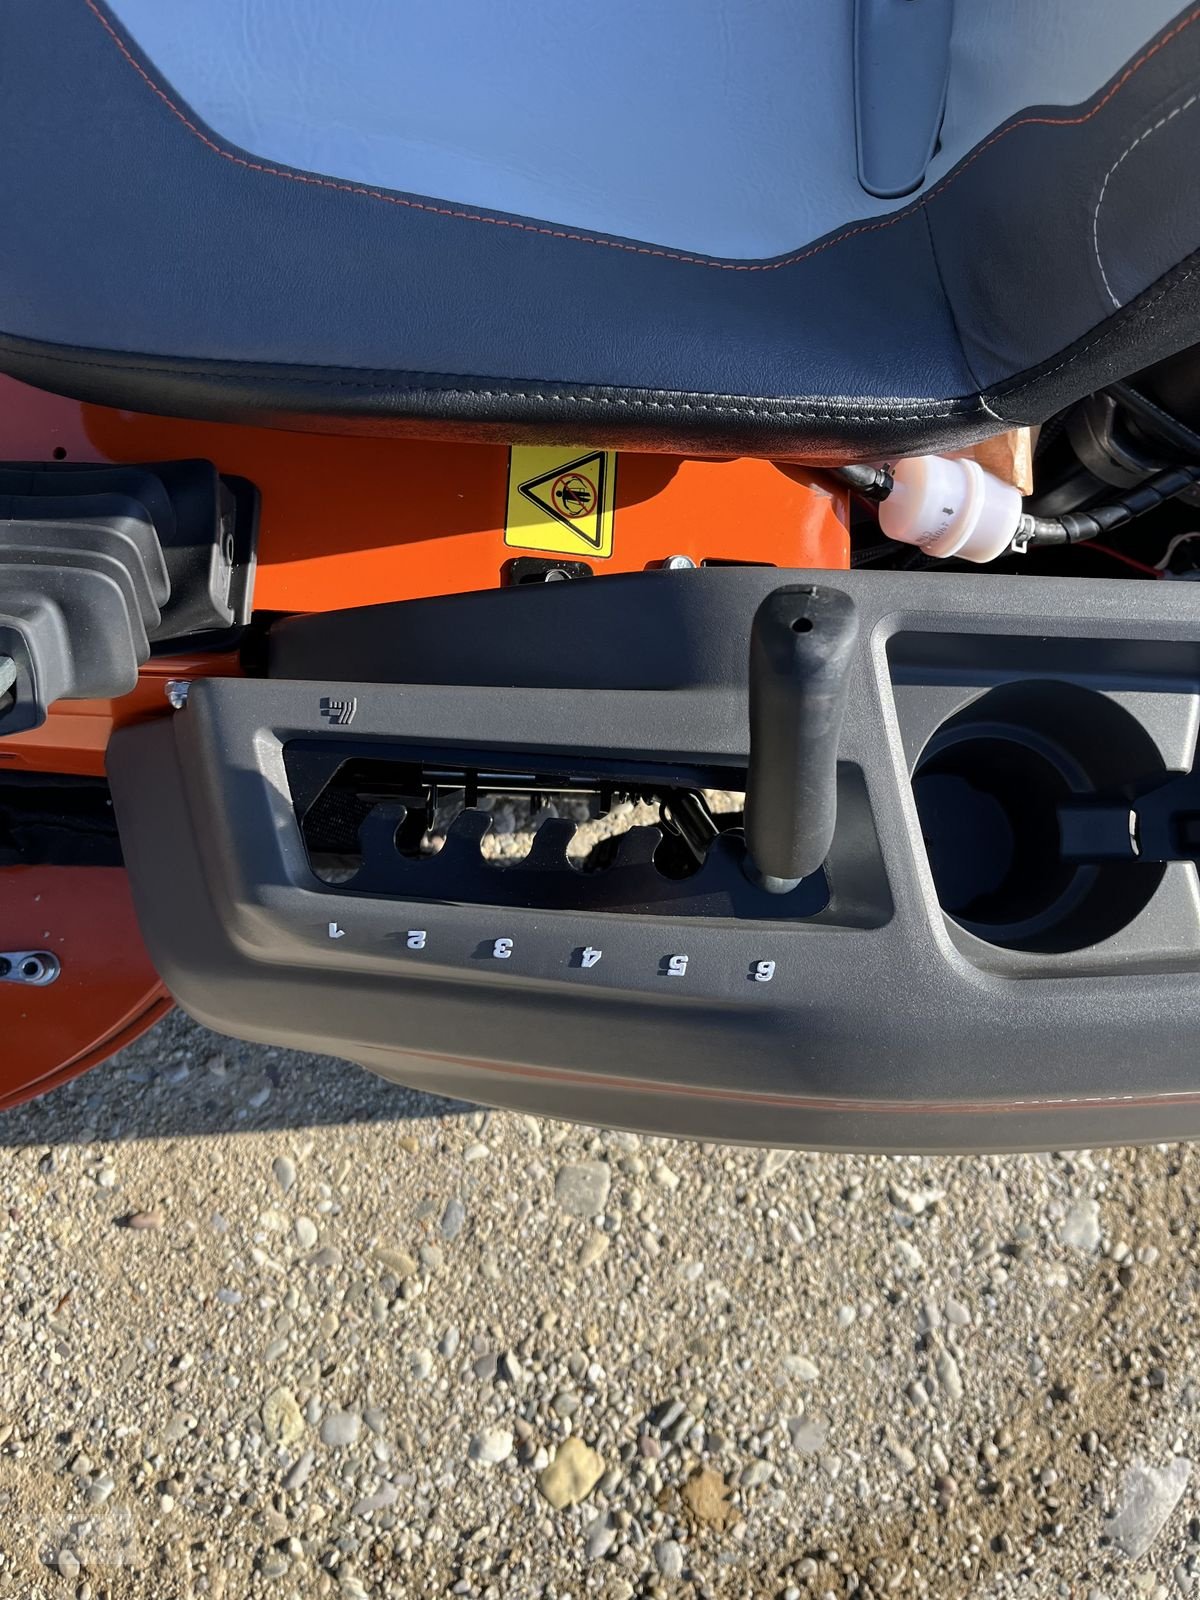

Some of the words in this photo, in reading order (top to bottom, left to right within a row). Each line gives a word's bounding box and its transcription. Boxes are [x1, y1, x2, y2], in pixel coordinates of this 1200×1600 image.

[329, 922, 345, 939] 1
[407, 930, 426, 949] 2
[493, 938, 513, 959] 3
[581, 946, 602, 968] 4
[667, 954, 689, 977] 5
[755, 960, 776, 982] 6
